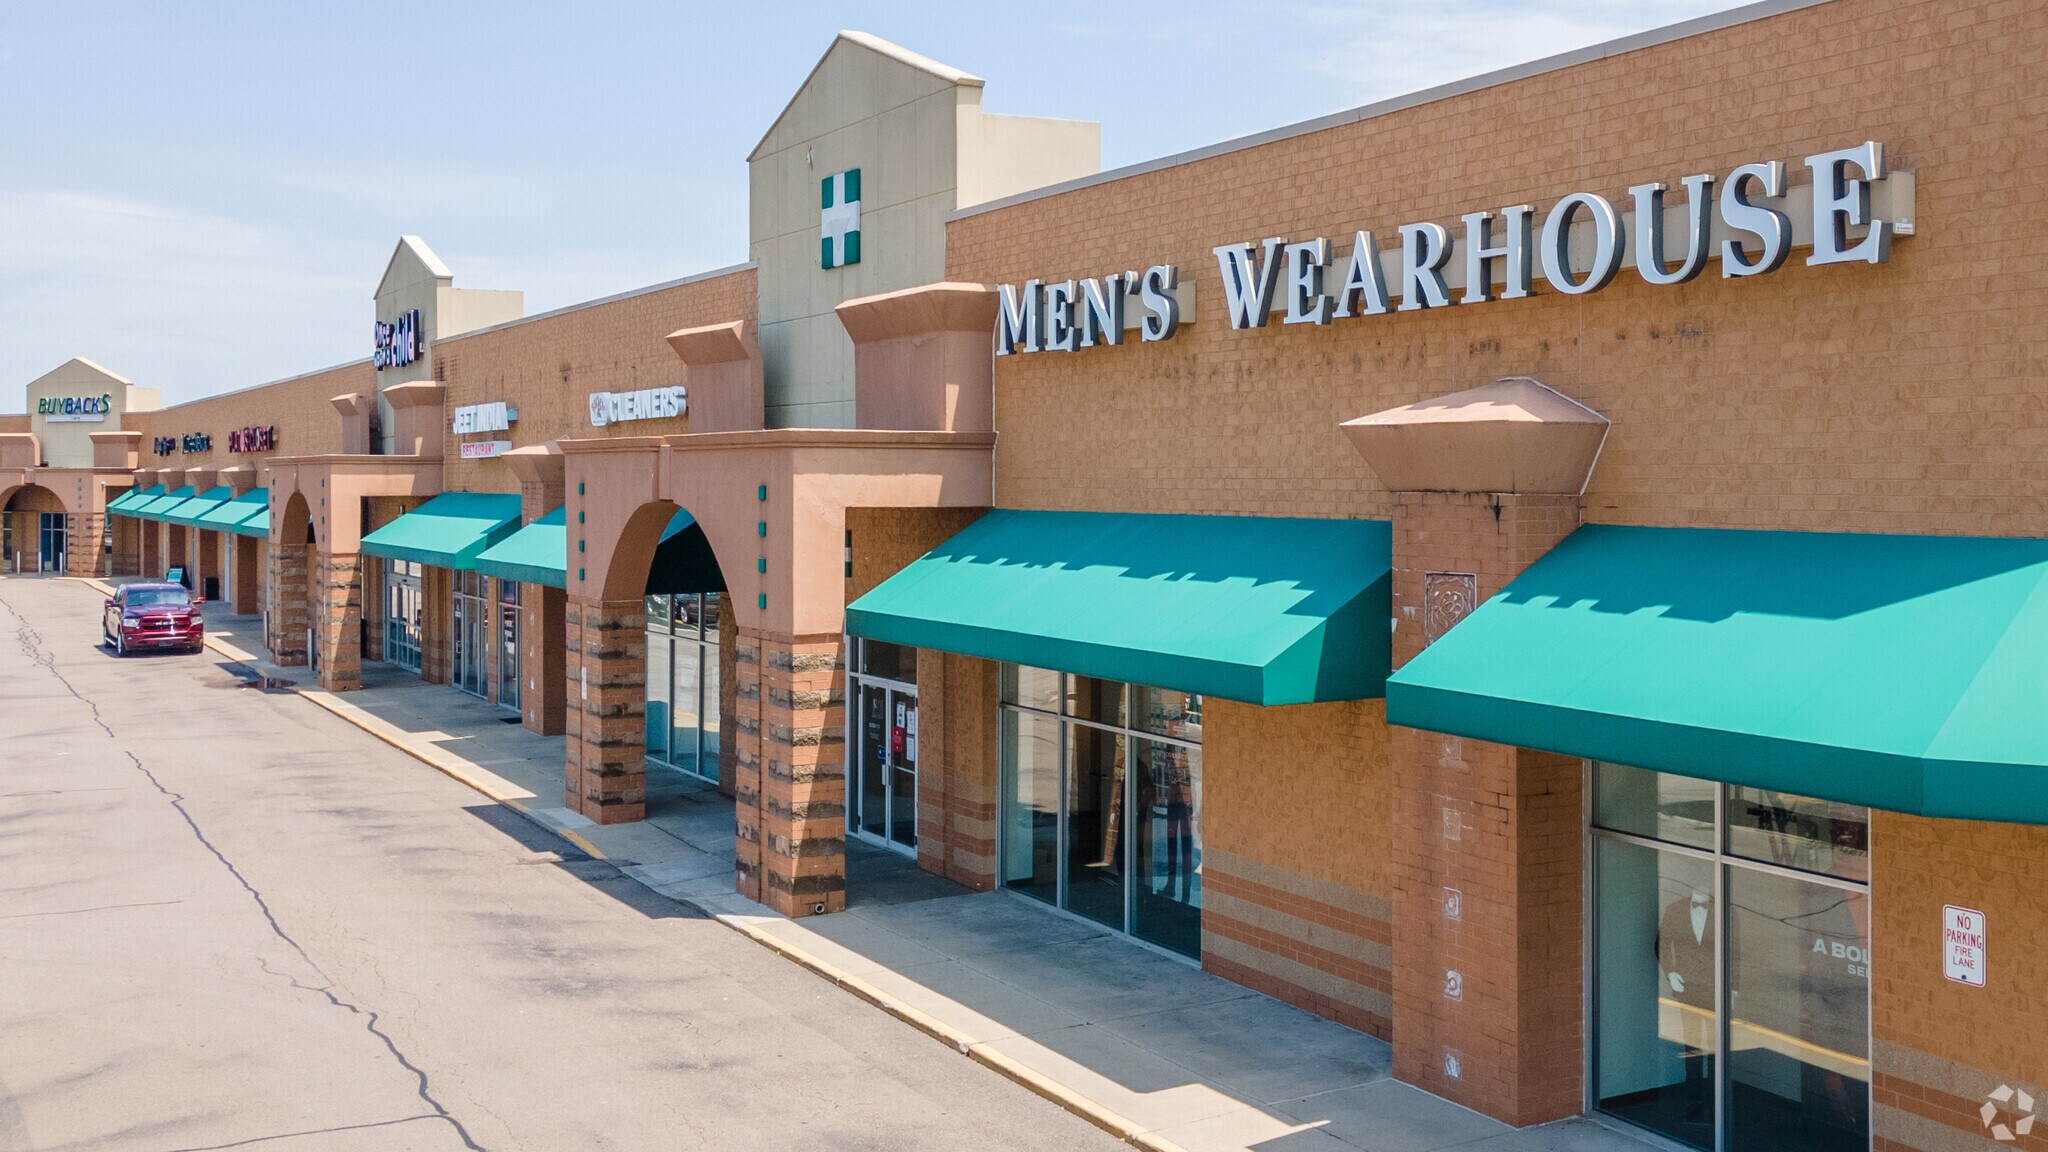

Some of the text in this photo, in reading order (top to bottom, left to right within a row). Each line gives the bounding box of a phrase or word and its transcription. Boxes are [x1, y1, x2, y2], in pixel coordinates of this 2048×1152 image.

[997, 140, 1886, 356] MEN'S WEARHOUSE
[38, 393, 111, 414] BUYBACKS
[609, 386, 686, 422] CLEANERS
[462, 443, 495, 457] RESTAURANT
[1957, 915, 1971, 930] NO
[1813, 938, 1827, 955] A
[1947, 929, 1982, 949] PARKING
[1955, 946, 1972, 958] FIRE
[1953, 956, 1975, 970] LANE
